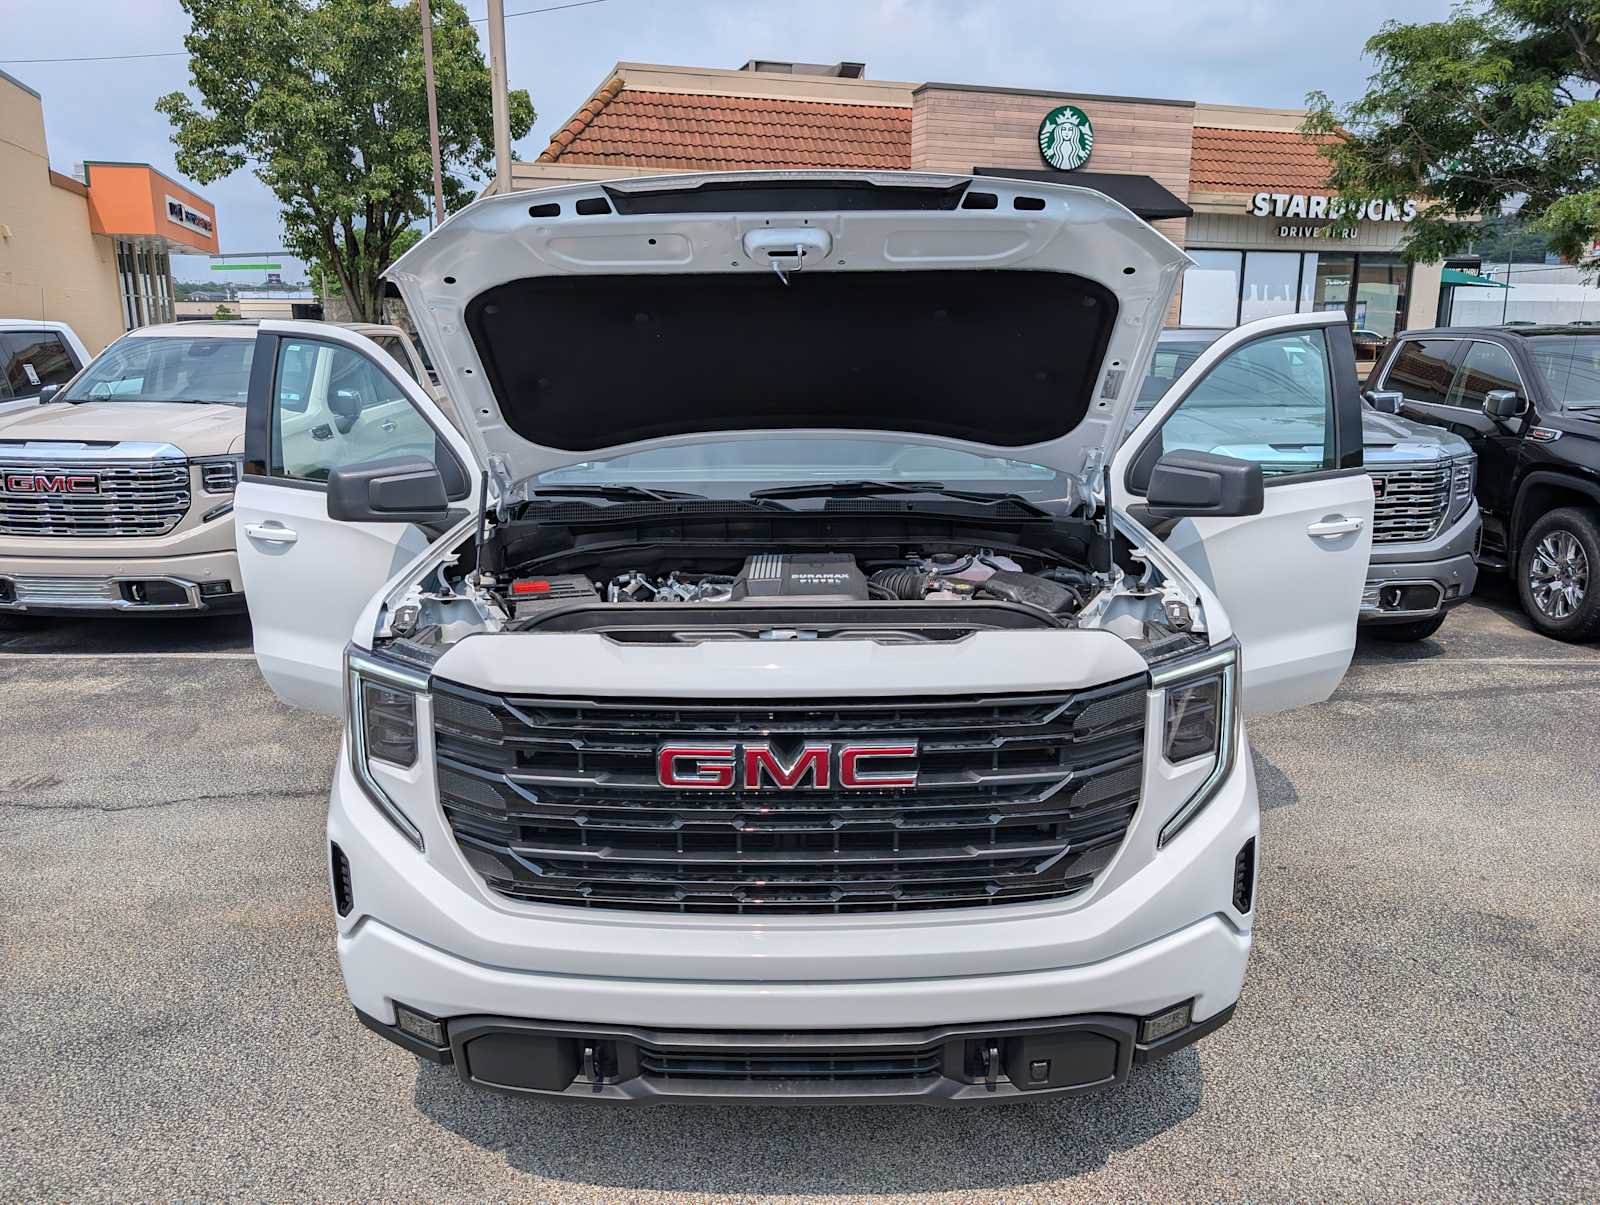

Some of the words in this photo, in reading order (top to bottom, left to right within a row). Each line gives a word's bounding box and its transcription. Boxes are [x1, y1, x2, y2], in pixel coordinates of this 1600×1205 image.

[1280, 226, 1320, 238] DRIVE
[1322, 227, 1358, 239] RU
[7, 475, 97, 493] GMC
[657, 741, 919, 790] GMC
